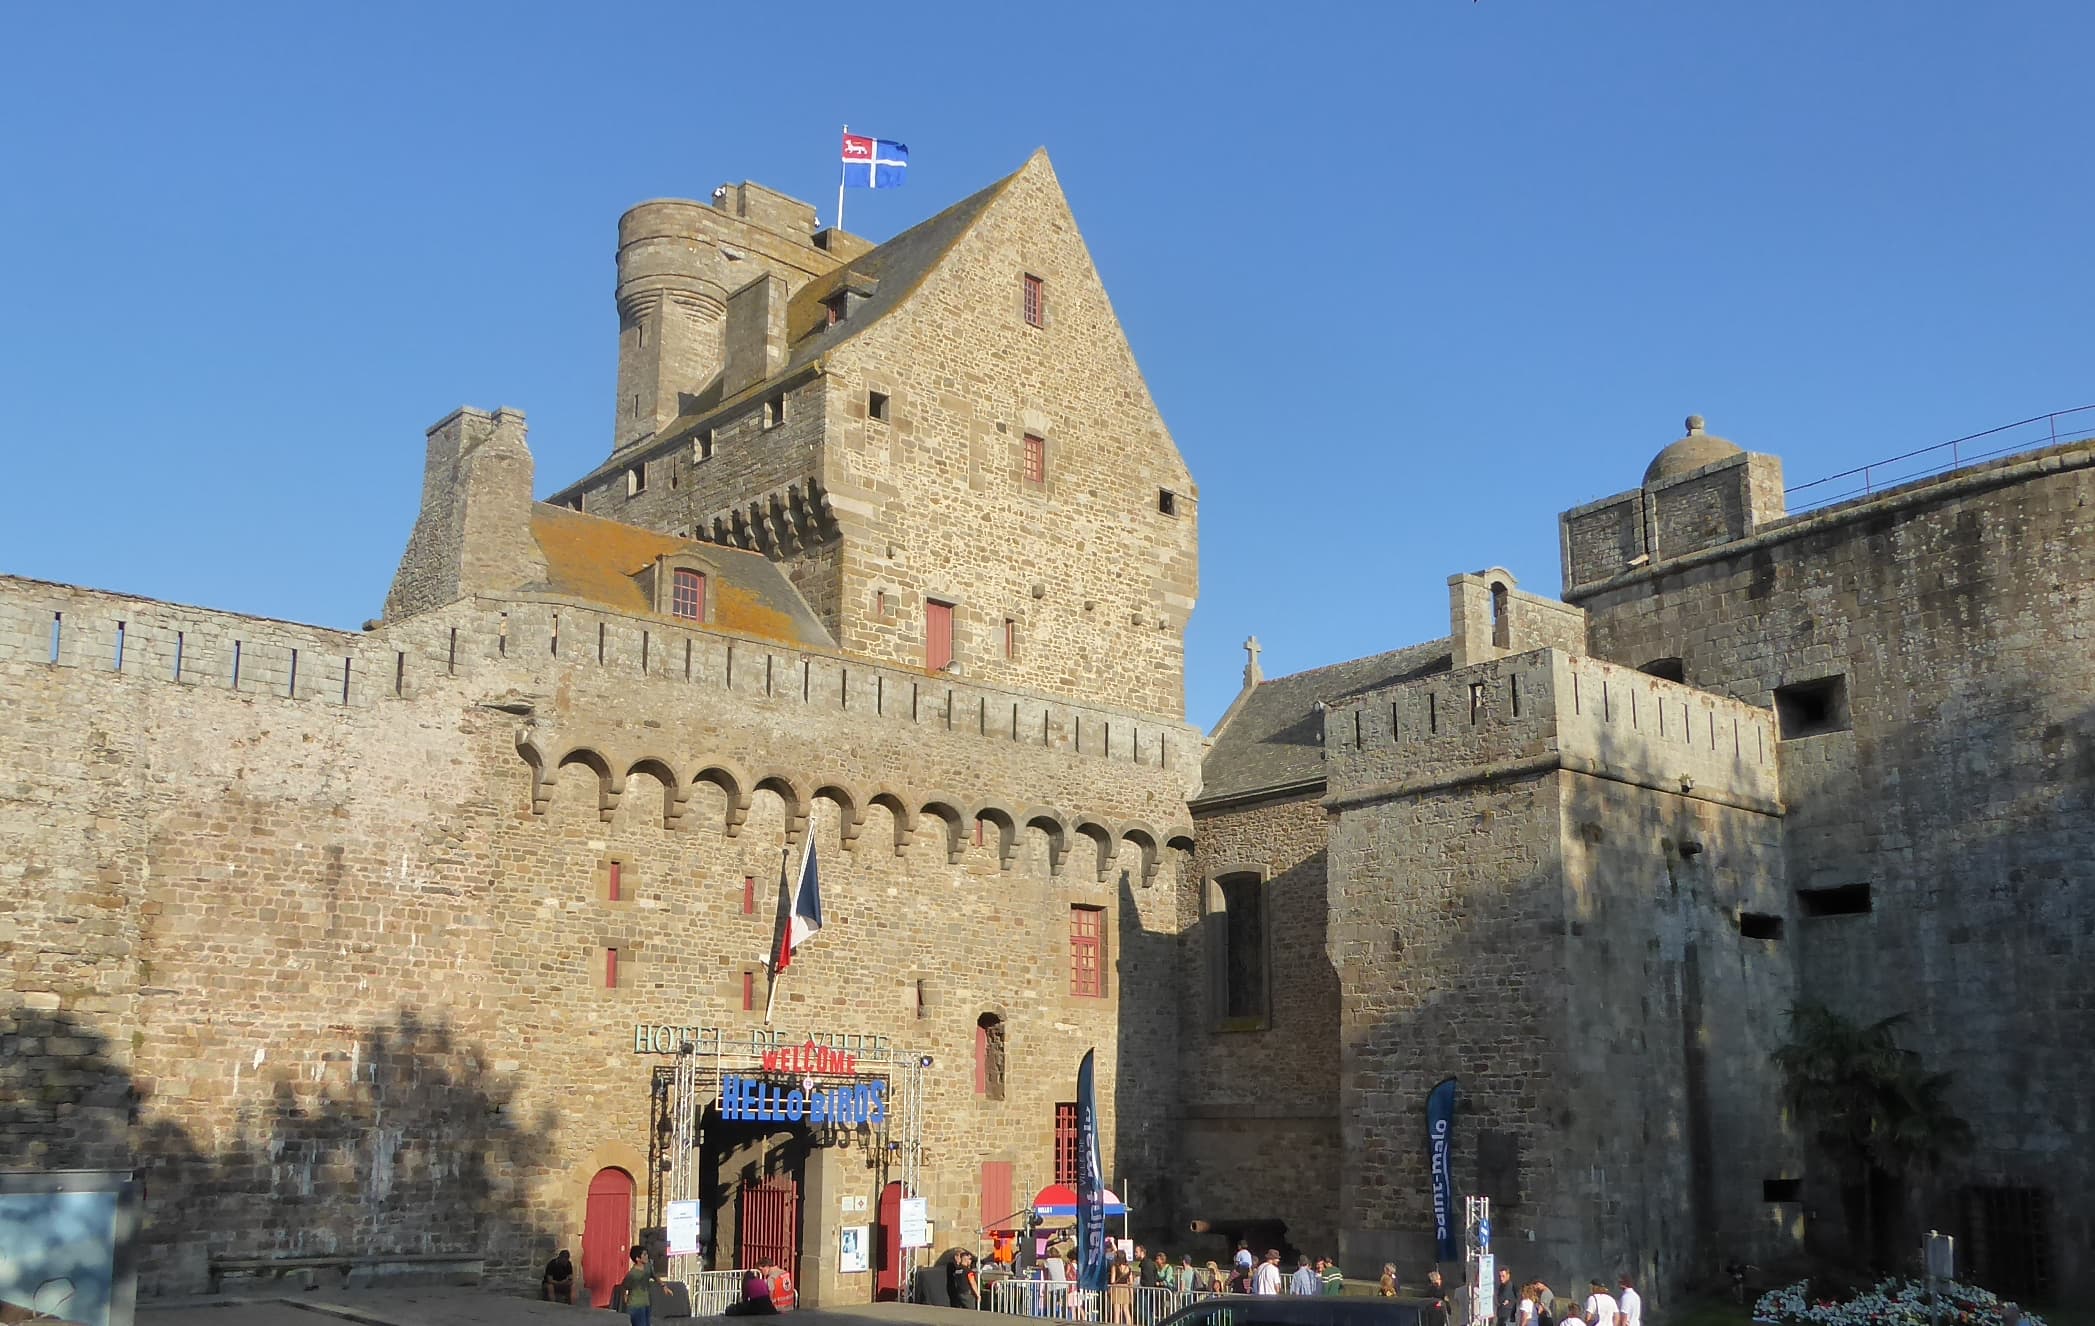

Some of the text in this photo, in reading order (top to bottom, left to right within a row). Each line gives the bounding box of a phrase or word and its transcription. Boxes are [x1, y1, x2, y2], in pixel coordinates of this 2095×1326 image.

[634, 1024, 721, 1055] HOTEL
[751, 1030, 788, 1057] DE
[762, 1040, 856, 1075] WELCOME
[722, 1074, 885, 1123] HELLO BIRDS
[1431, 1119, 1449, 1240] saint-malo
